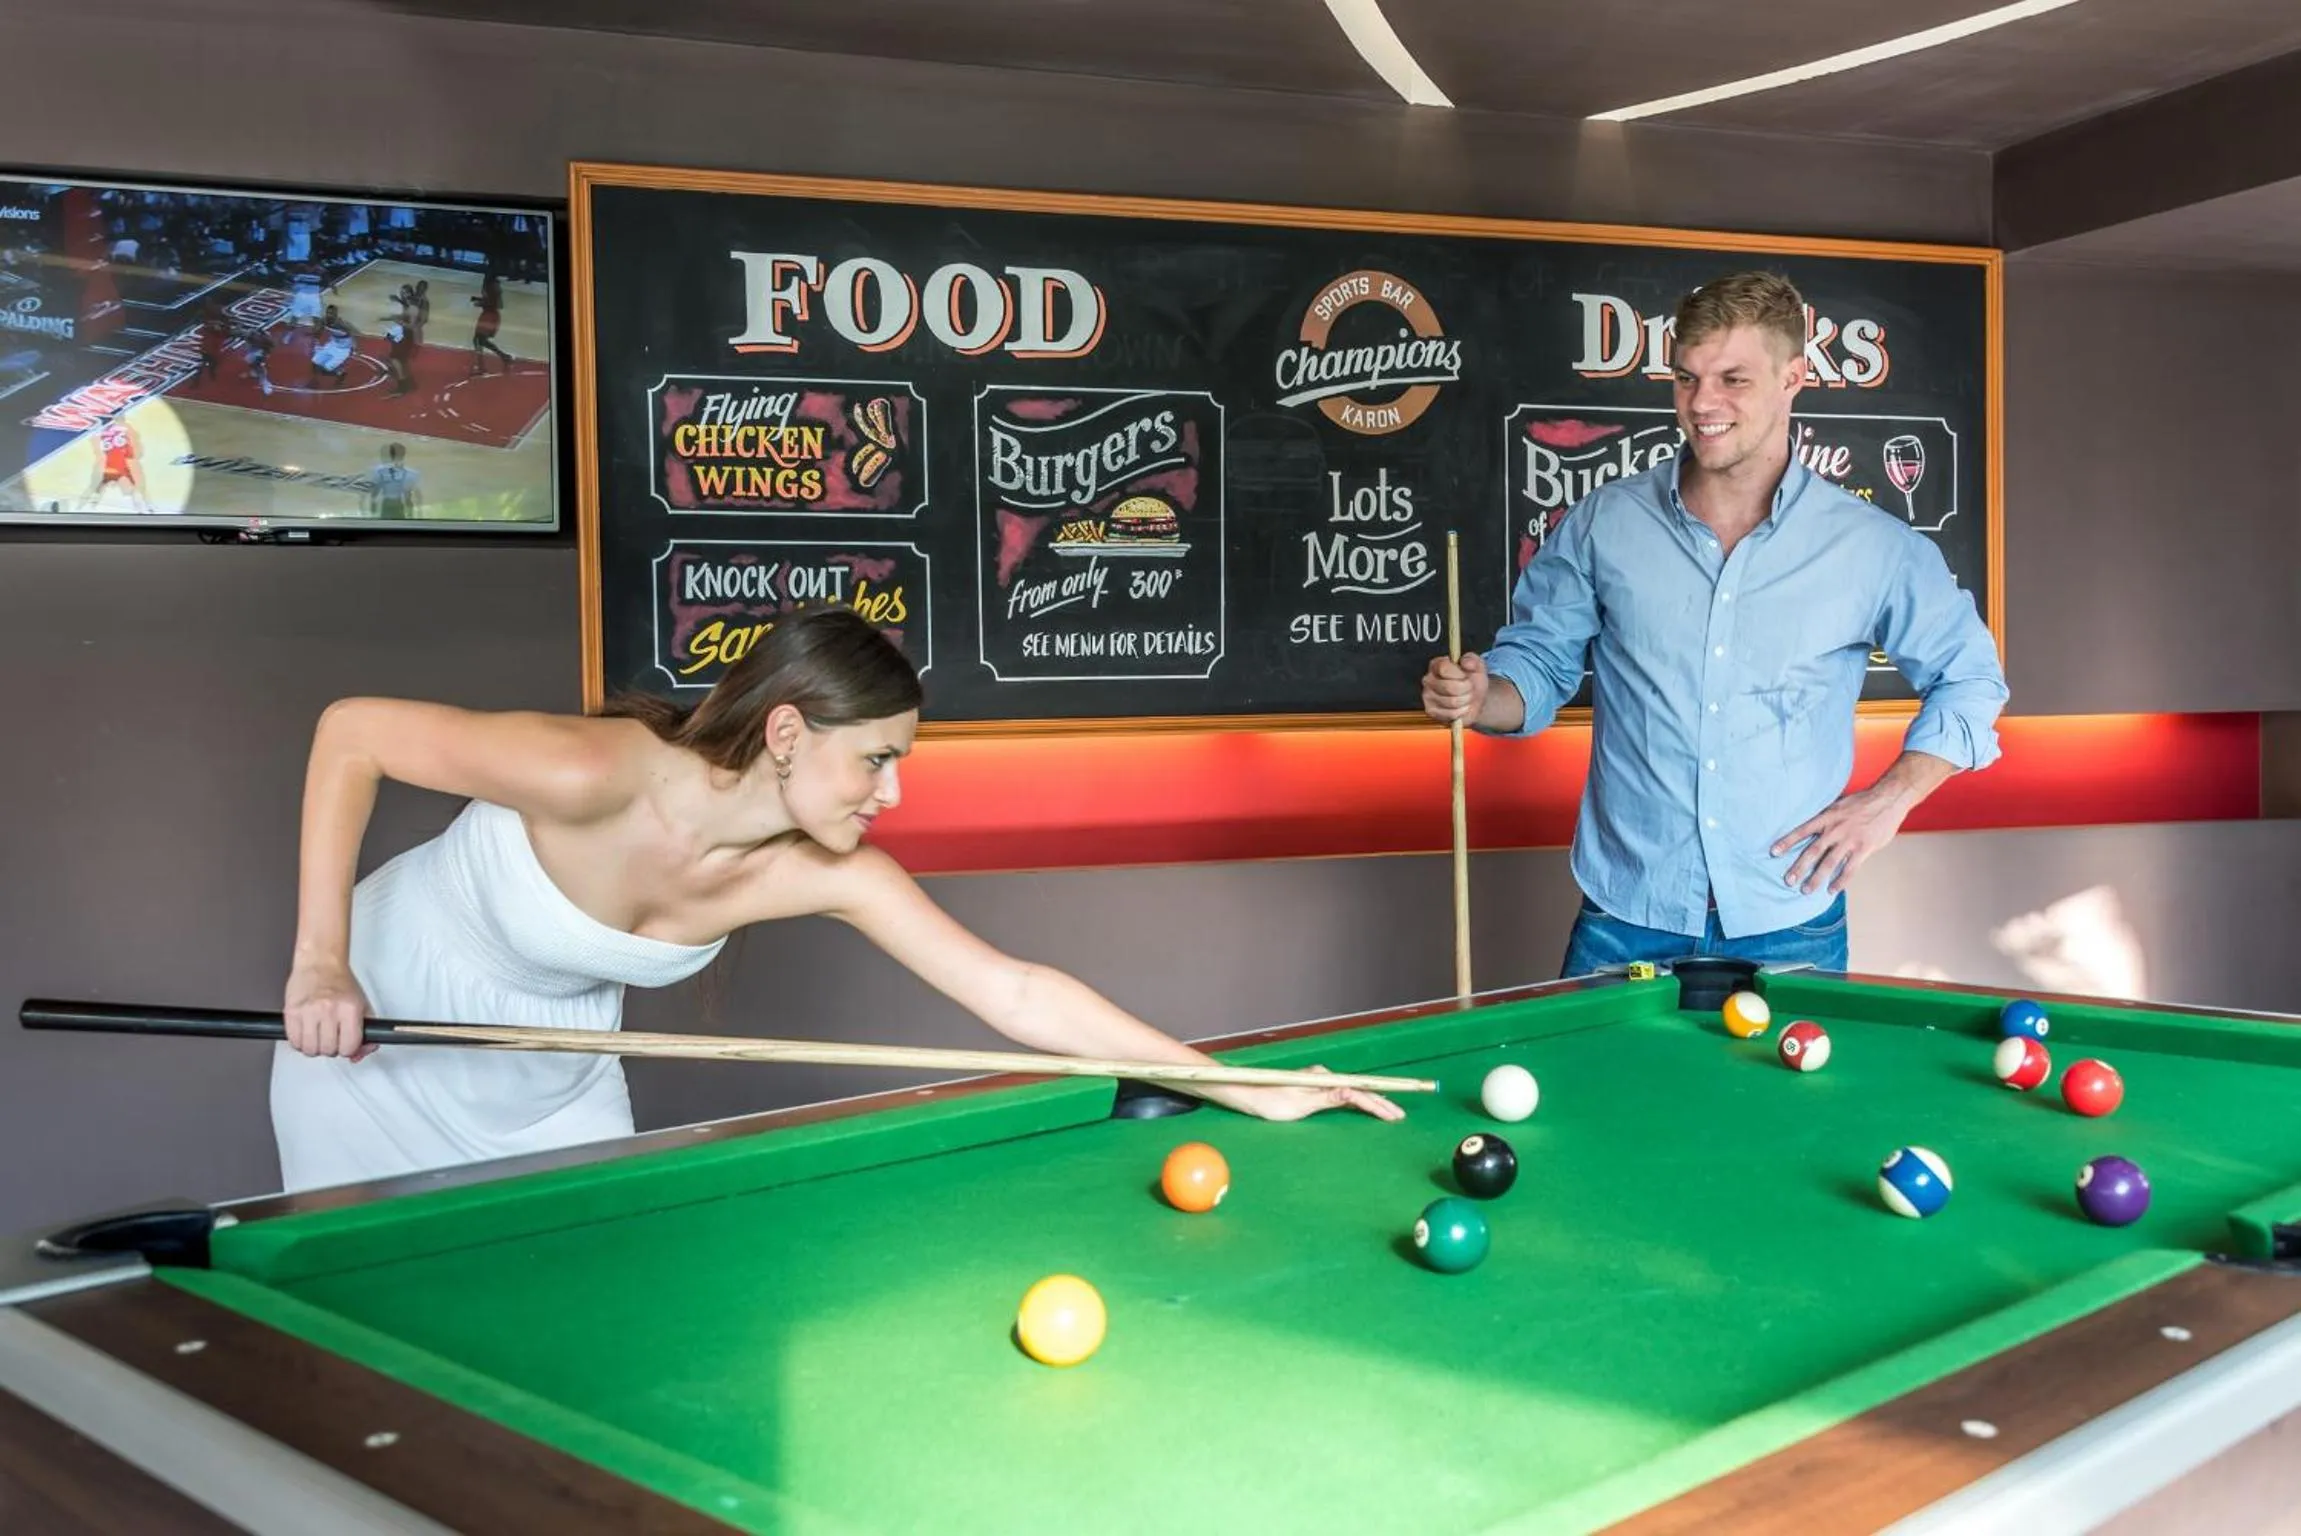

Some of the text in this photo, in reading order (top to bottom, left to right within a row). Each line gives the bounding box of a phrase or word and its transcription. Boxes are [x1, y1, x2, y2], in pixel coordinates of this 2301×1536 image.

[728, 250, 1107, 360] FOOD
[1315, 276, 1416, 322] SPORTS BAR
[1275, 327, 1462, 394] Champions
[1572, 292, 1890, 388] Drks
[700, 386, 798, 443] Flying
[1340, 405, 1402, 429] KARON
[674, 423, 825, 468] CHICKEN
[988, 410, 1178, 505] Burgers
[693, 465, 824, 501] WINGS
[1327, 468, 1414, 522] Lots
[1528, 510, 1548, 547] of
[684, 562, 850, 601] KNOCK OUT
[1302, 531, 1429, 589] More
[1007, 579, 1058, 620] from
[1061, 555, 1110, 609] only
[1022, 631, 1051, 658] SEE
[1055, 631, 1106, 659] MENU
[1109, 631, 1139, 660] FOR
[1289, 612, 1443, 644] SEE MENU
